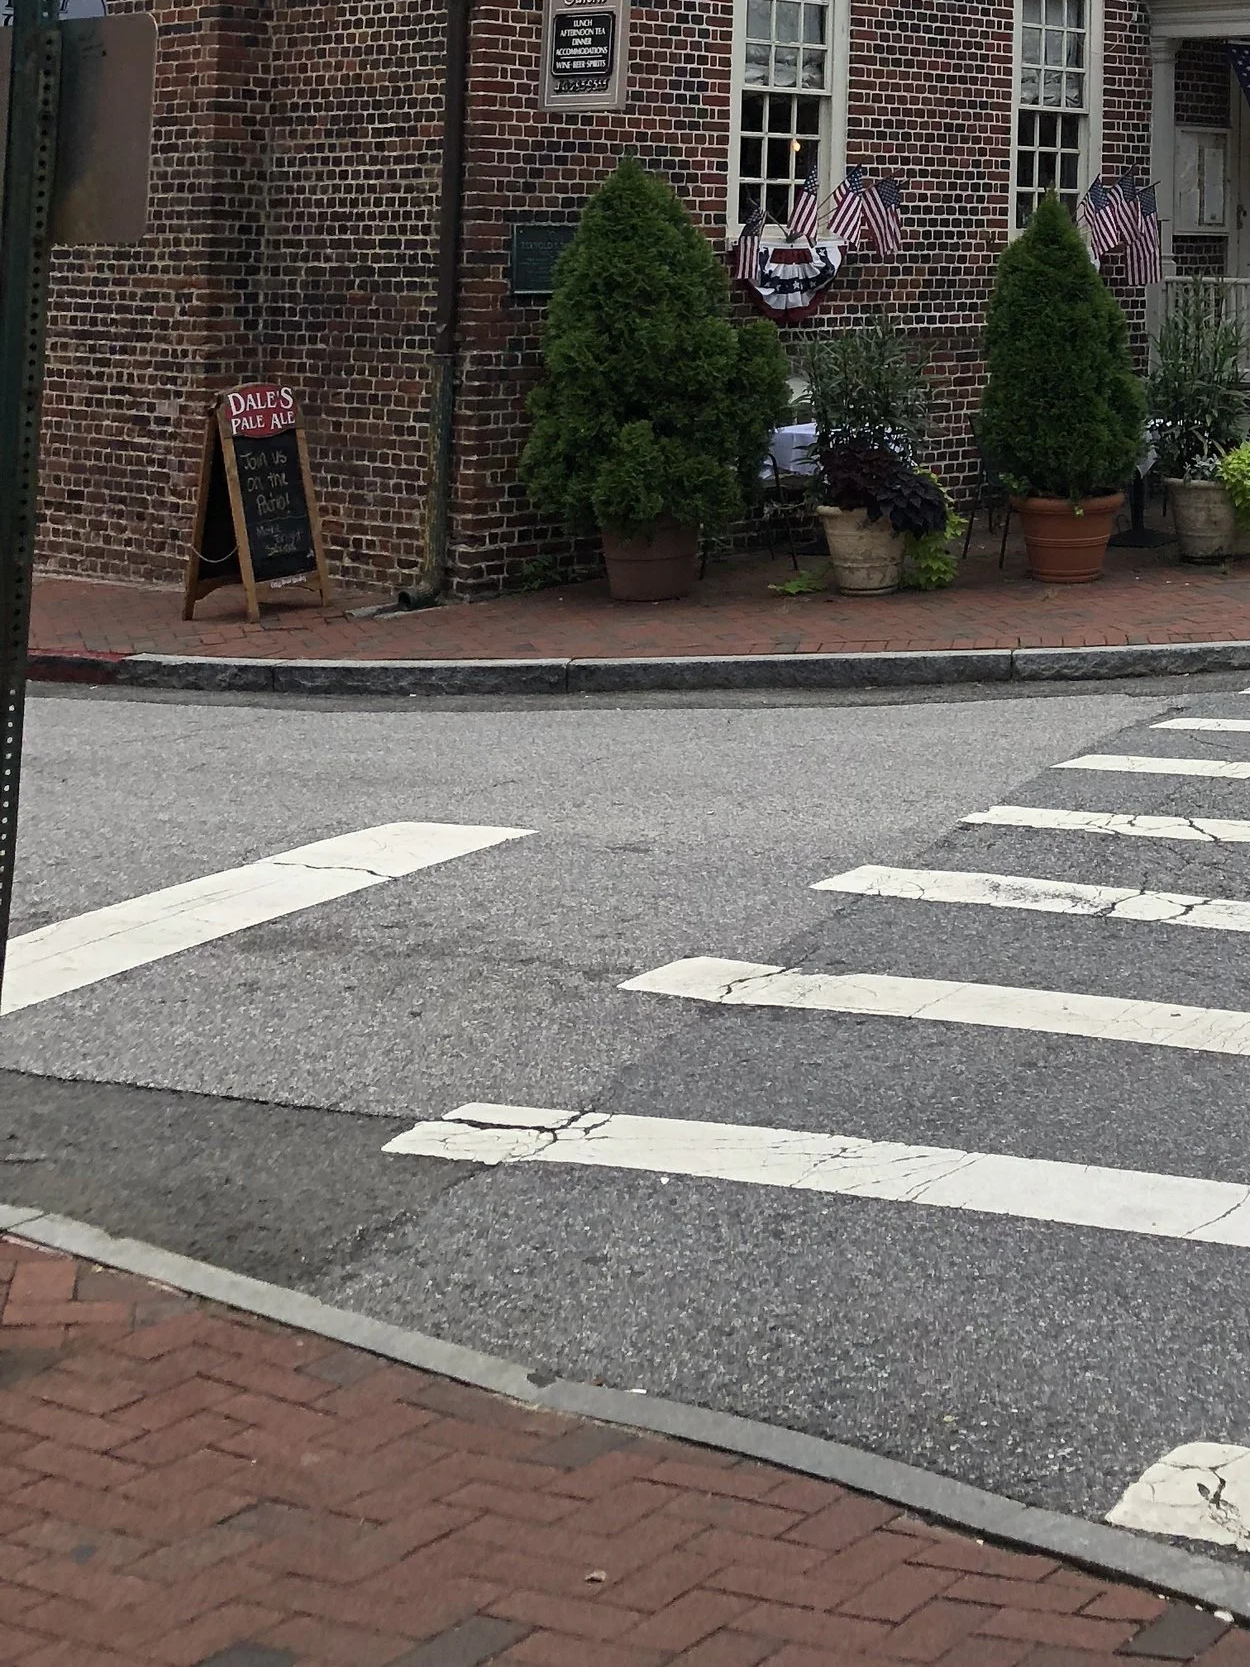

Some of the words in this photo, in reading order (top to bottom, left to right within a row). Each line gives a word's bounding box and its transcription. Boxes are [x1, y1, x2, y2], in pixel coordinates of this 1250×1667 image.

[573, 19, 593, 27] LUNCH
[560, 28, 594, 37] AFTERNOON
[595, 27, 606, 35] TEA
[571, 37, 592, 46] DINNER
[556, 46, 608, 56] ACCOMMODATIONS
[227, 387, 294, 416] DALE'S
[231, 415, 265, 435] PALE
[270, 411, 296, 430] ALE
[240, 452, 268, 470] Join
